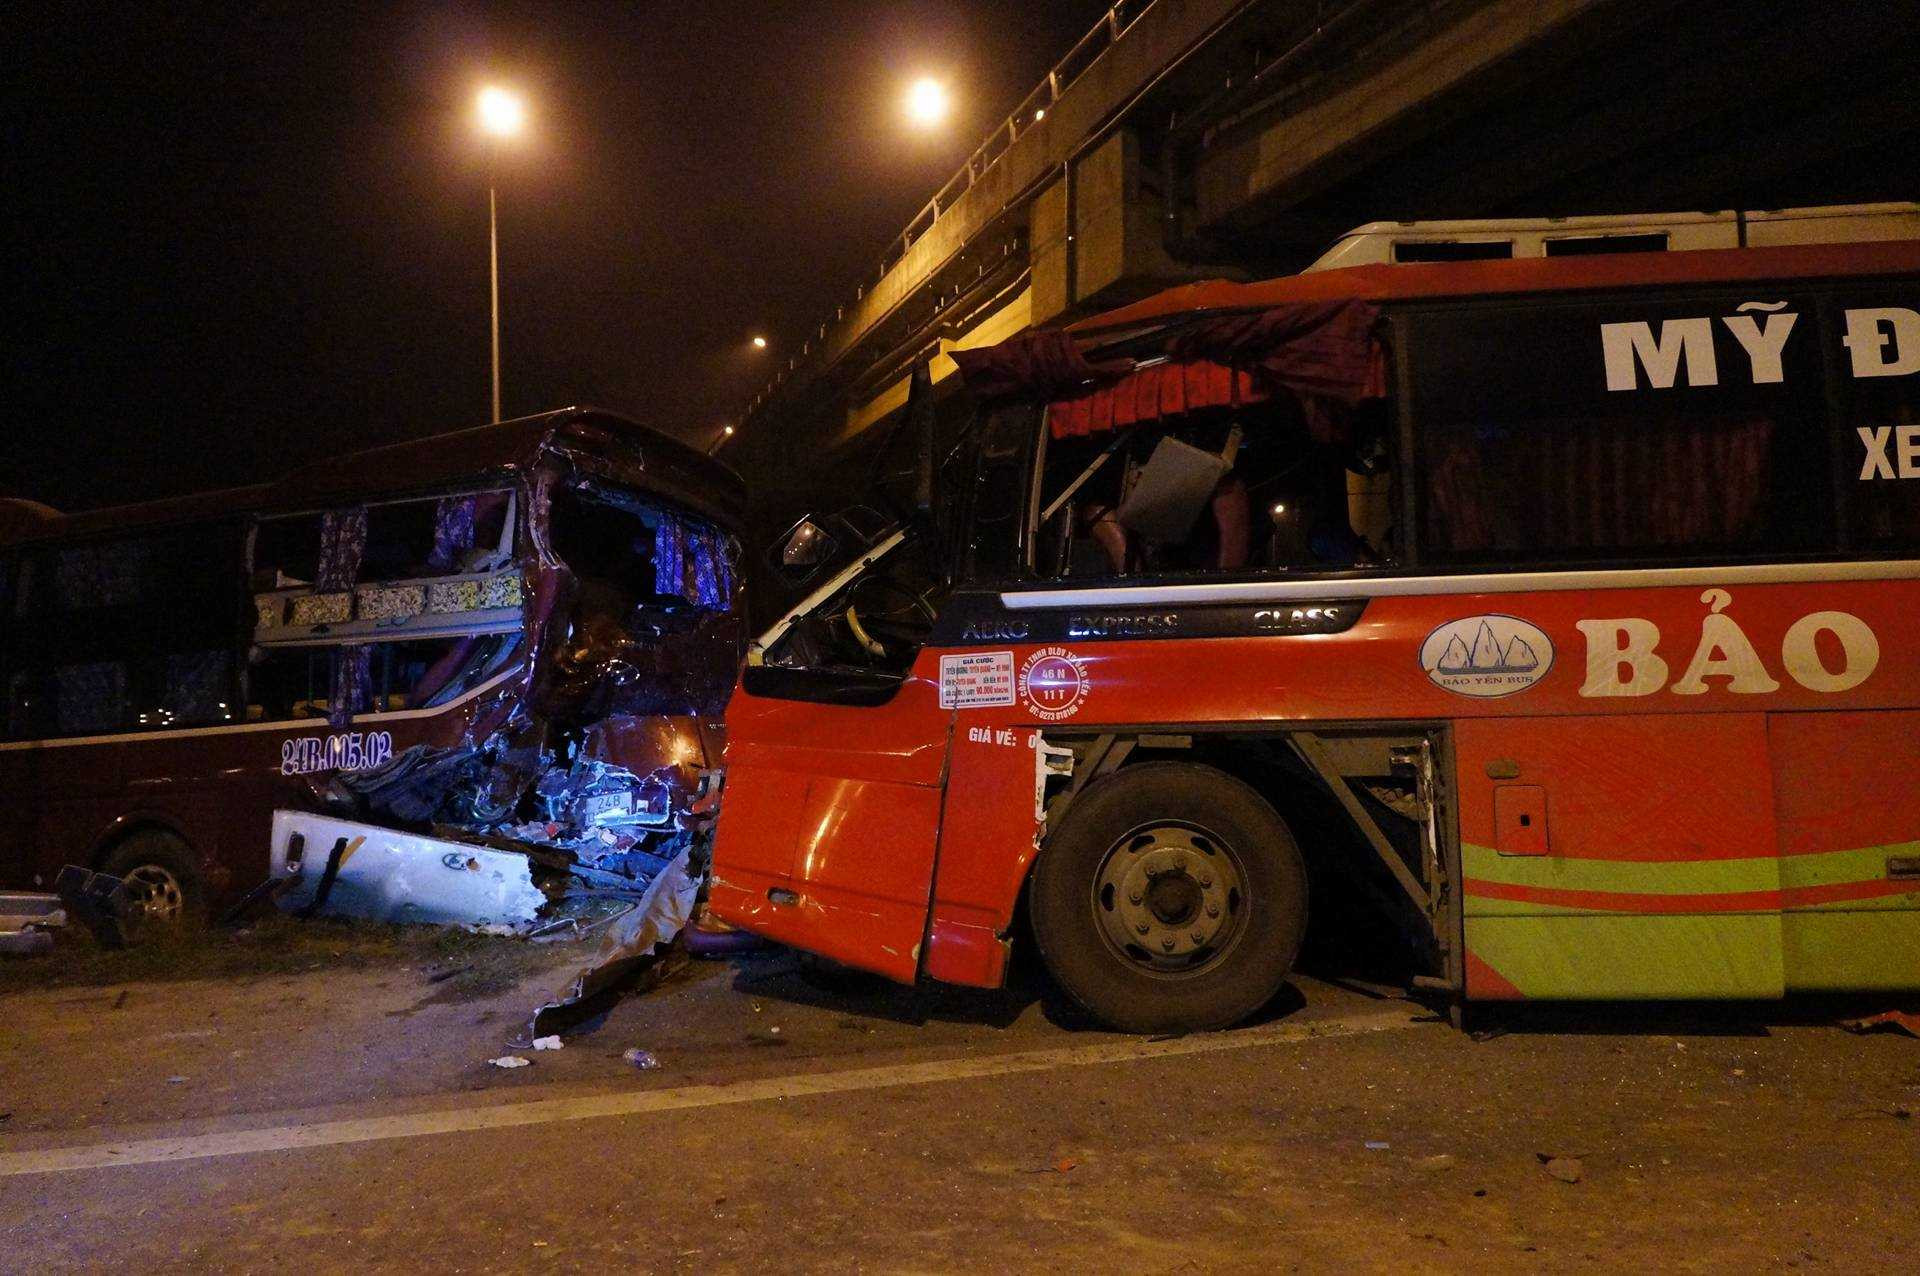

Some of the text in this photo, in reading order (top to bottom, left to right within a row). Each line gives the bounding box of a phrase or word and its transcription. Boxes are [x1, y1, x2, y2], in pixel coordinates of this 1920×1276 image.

[1601, 300, 1799, 391] MỸ
[1856, 424, 1920, 481] XE
[1575, 588, 1880, 698] BẢO
[1042, 669, 1065, 679] 46 N
[1044, 690, 1065, 700] 11 T
[969, 725, 992, 744] GIÁ
